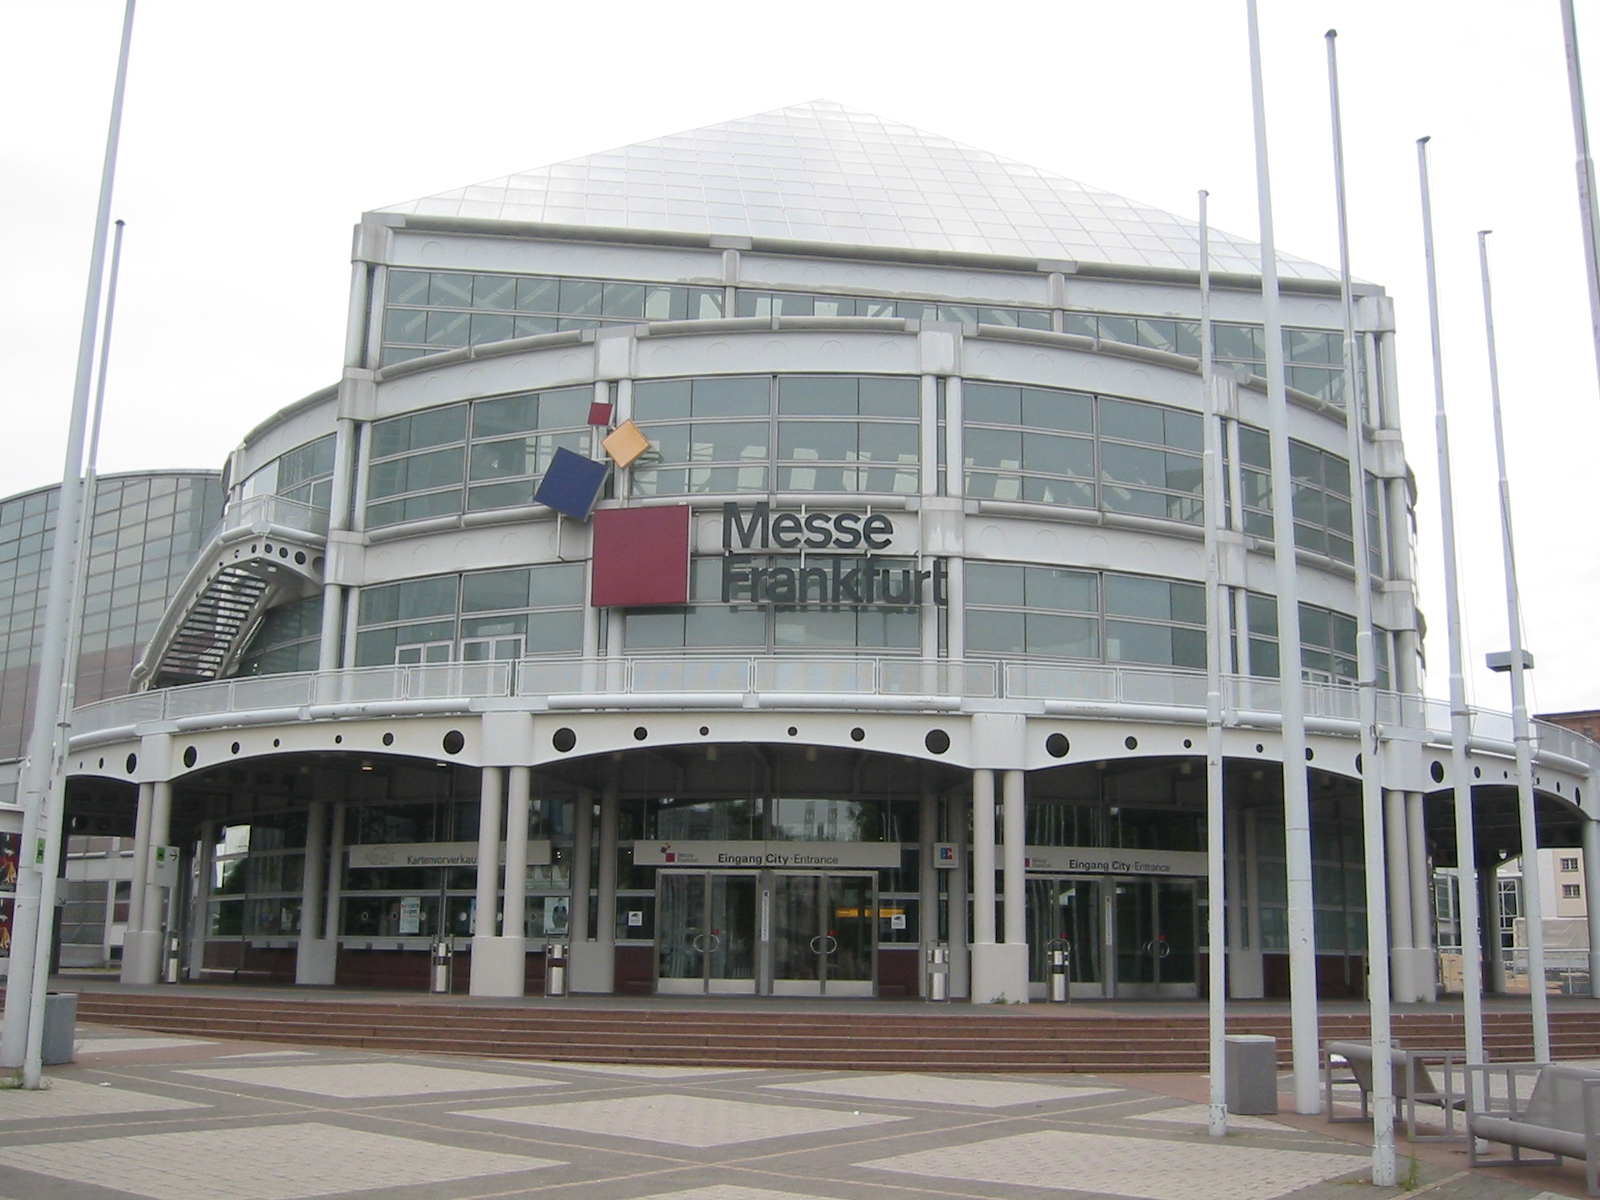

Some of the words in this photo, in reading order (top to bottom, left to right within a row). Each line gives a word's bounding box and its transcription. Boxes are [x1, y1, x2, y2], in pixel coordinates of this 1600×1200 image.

[722, 502, 893, 549] Messe
[722, 554, 949, 606] Frankfurt
[407, 855, 477, 865] Kartenvorverkau
[718, 853, 762, 865] Eingang
[766, 854, 789, 865] City
[794, 853, 838, 864] Entrance
[1069, 859, 1109, 871] Eingang
[1112, 860, 1131, 872] City
[1134, 861, 1170, 872] Entrance
